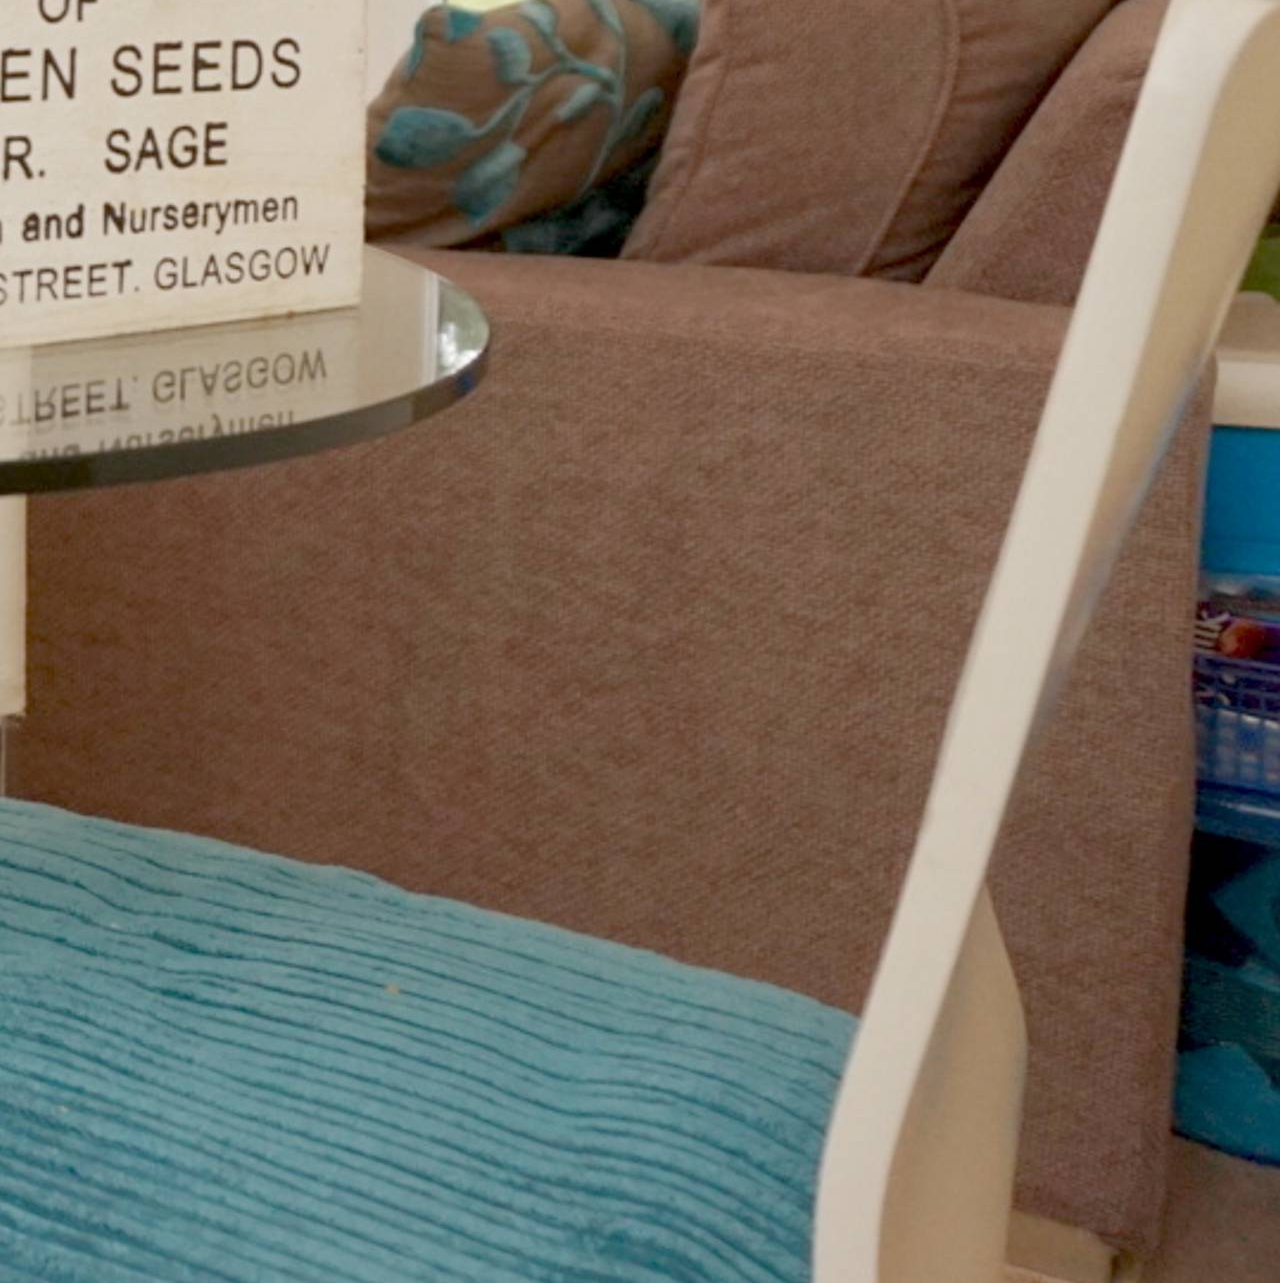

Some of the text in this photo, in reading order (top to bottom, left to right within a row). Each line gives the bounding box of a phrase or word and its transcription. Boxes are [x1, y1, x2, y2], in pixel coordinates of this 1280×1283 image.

[110, 37, 303, 98] SEEDS
[104, 121, 229, 174] SAGE
[21, 203, 86, 243] and
[102, 195, 299, 236] Nurserymen
[153, 243, 332, 291] GLASGOW
